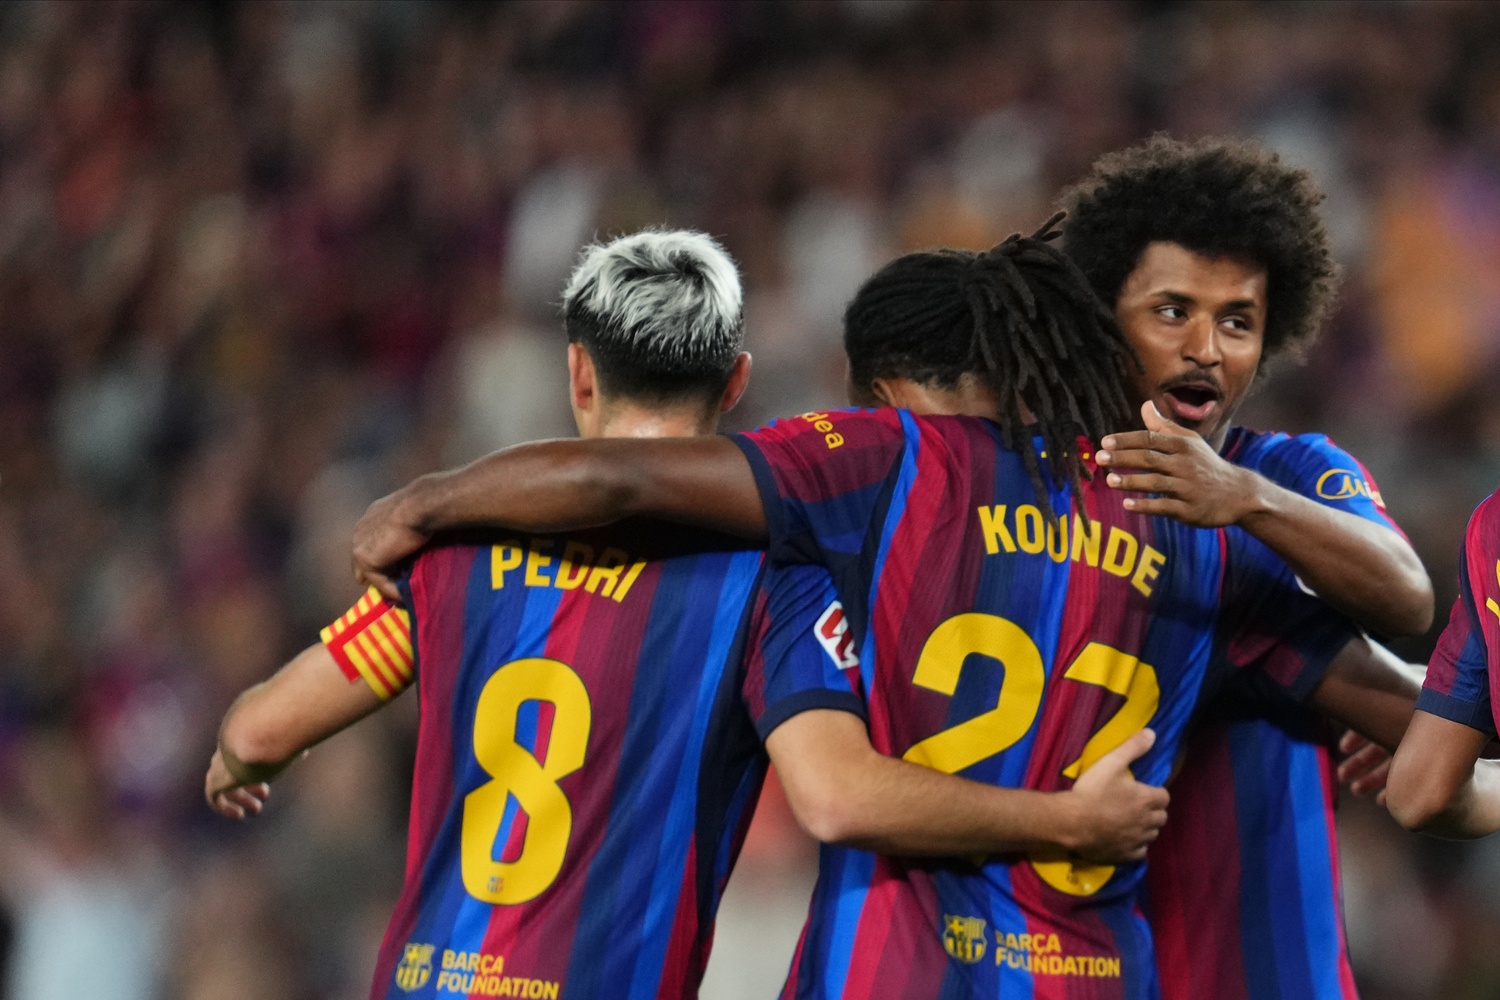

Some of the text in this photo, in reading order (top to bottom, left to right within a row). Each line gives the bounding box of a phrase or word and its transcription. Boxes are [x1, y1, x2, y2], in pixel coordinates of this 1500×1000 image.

[801, 412, 845, 450] dea
[977, 503, 1167, 598] KOUNDE
[491, 538, 648, 603] PEDRI
[461, 657, 593, 906] 8
[442, 949, 504, 975] BARÇA
[996, 947, 1120, 976] FOUNDATION
[437, 972, 559, 1000] FOUNDATION
